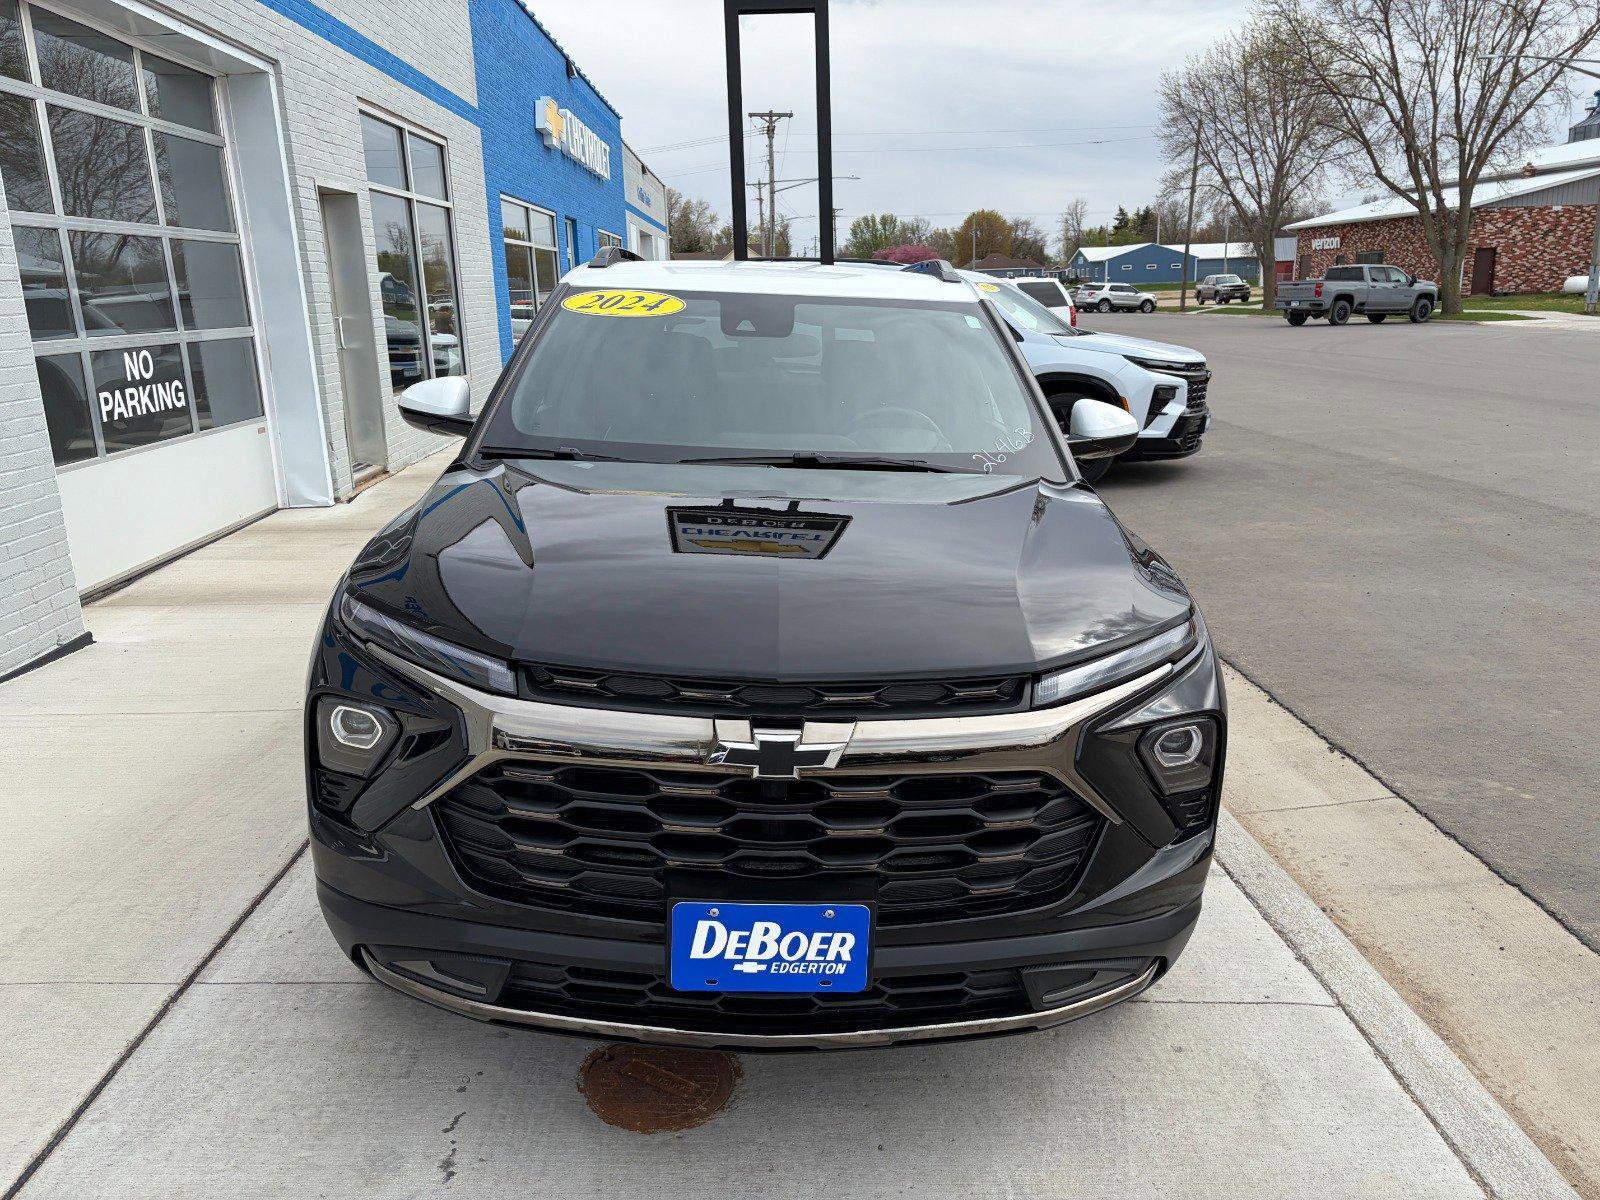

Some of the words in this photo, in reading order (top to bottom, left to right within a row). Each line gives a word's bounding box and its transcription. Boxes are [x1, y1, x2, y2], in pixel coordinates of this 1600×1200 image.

[576, 294, 671, 312] 2024
[123, 349, 154, 382] NO
[98, 380, 186, 423] PARKING
[770, 961, 847, 975] EDGERTON
